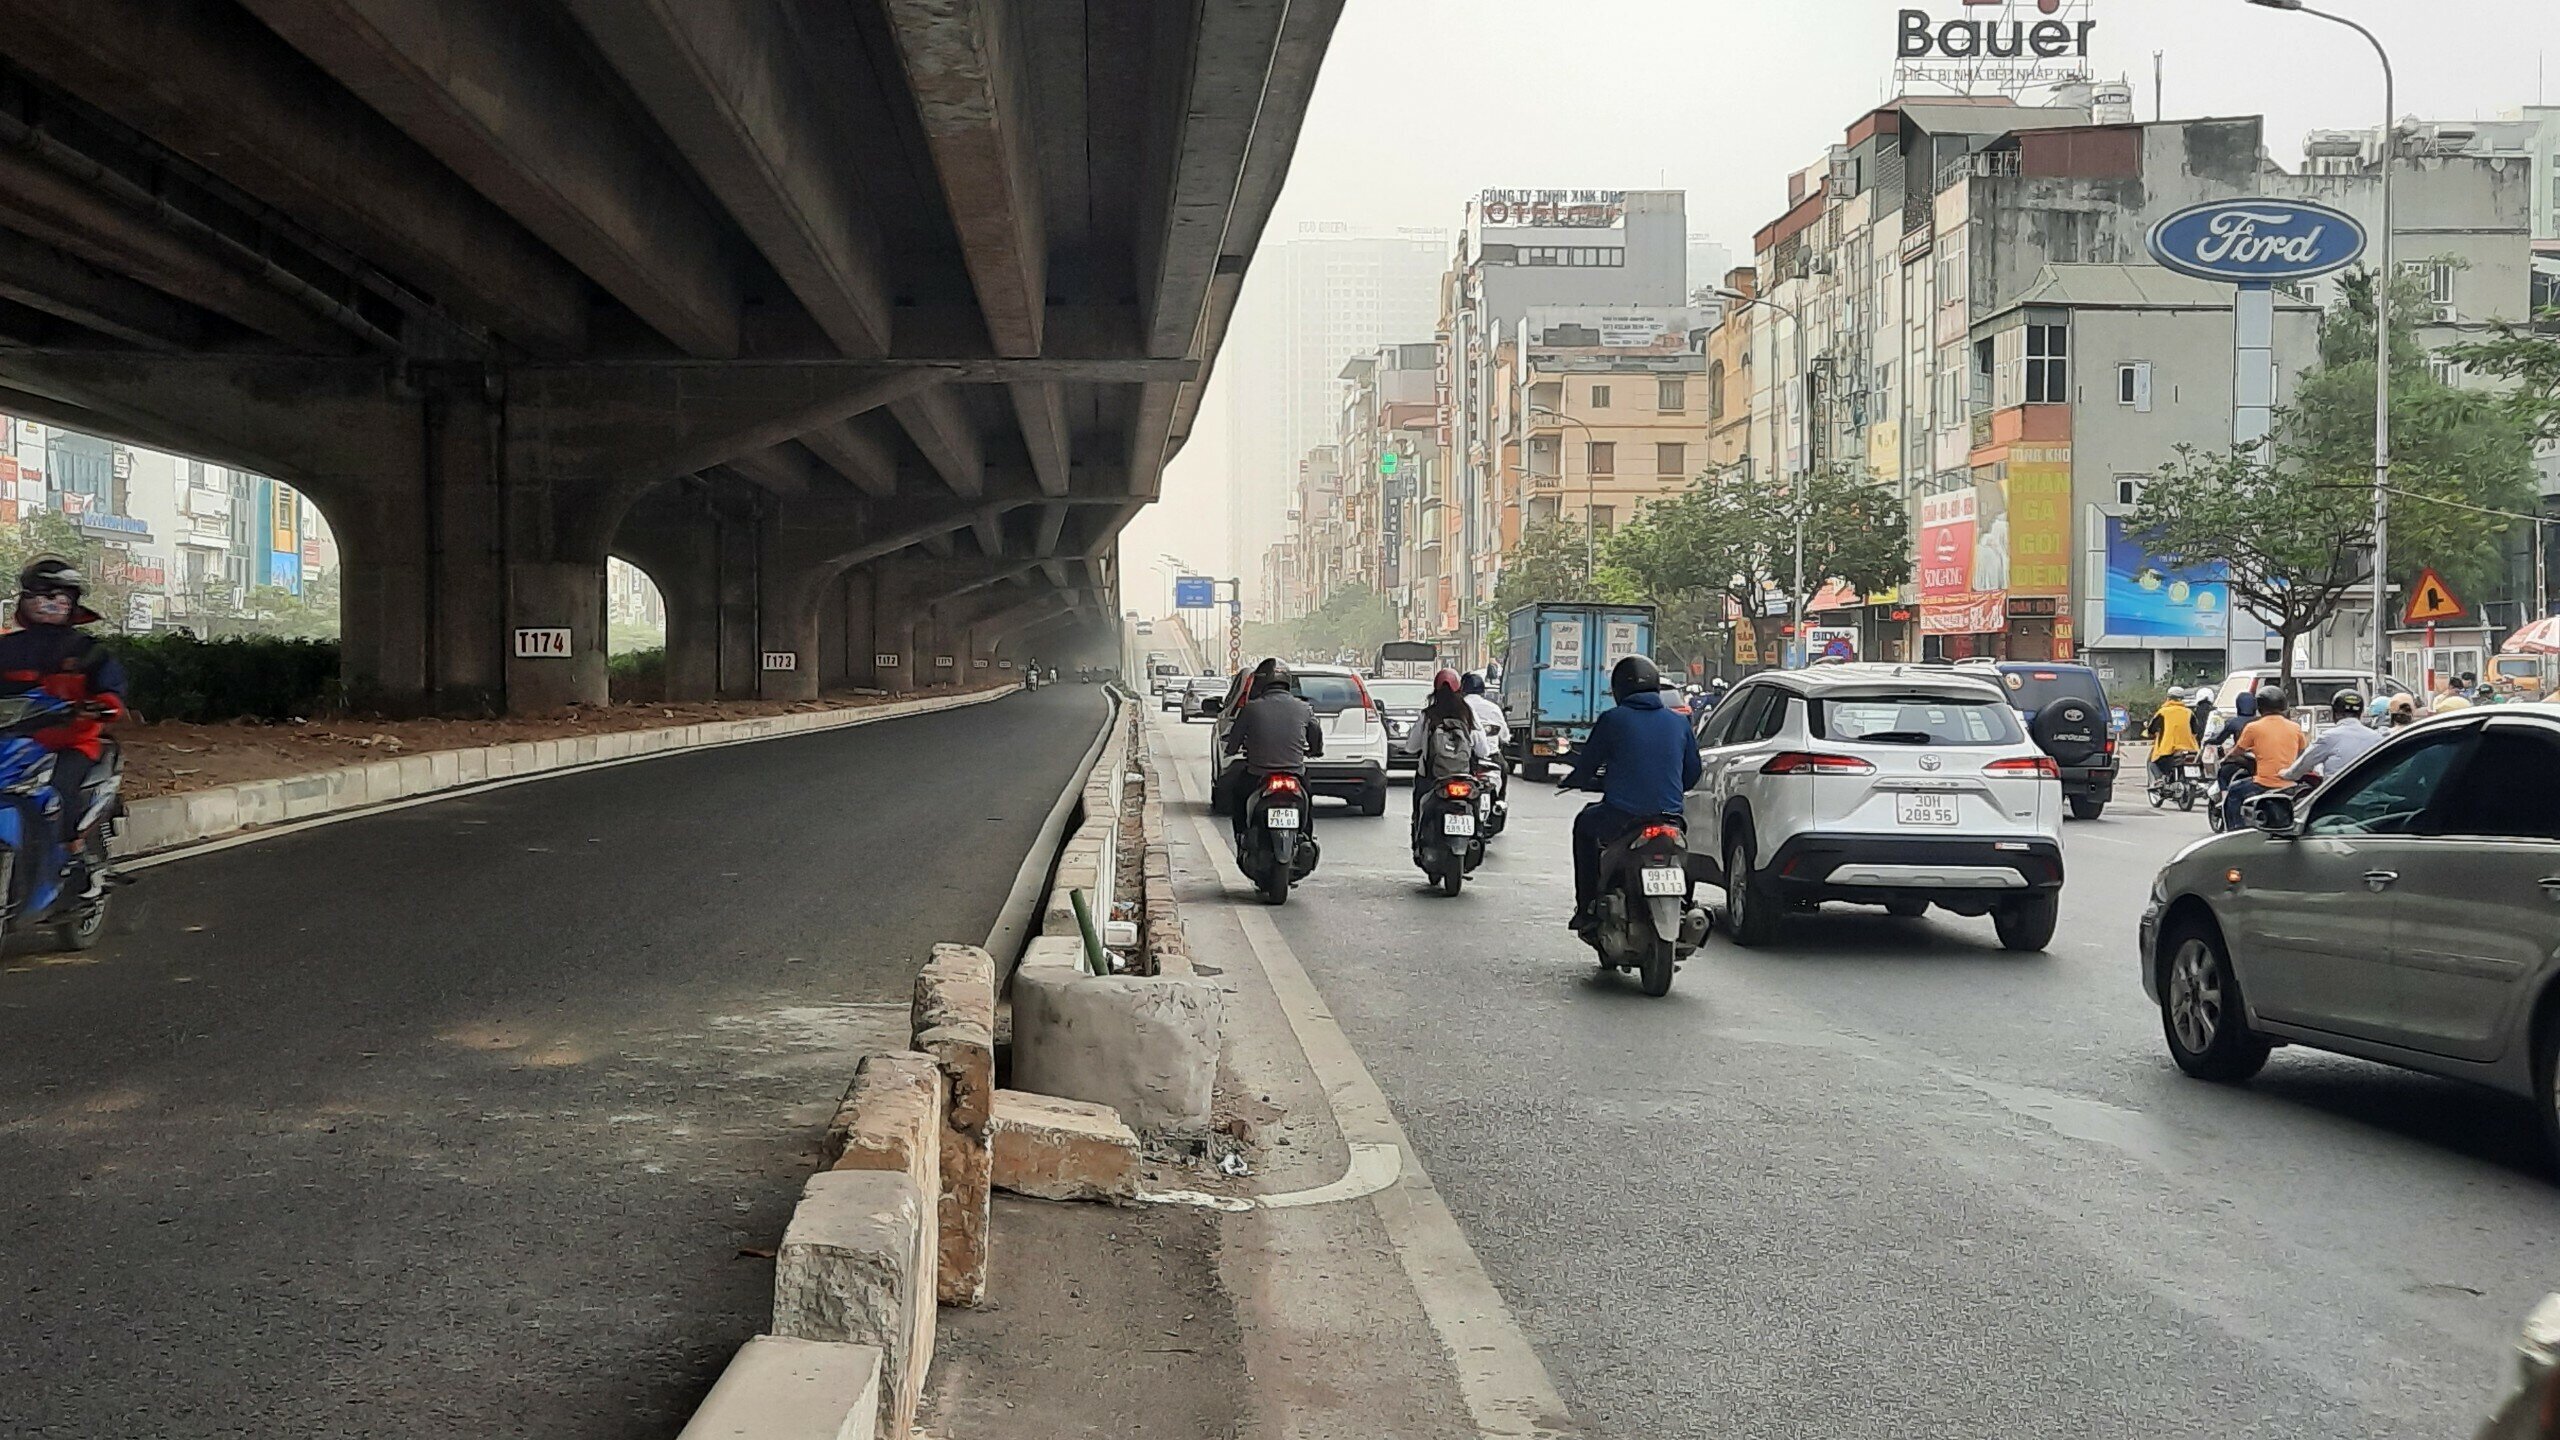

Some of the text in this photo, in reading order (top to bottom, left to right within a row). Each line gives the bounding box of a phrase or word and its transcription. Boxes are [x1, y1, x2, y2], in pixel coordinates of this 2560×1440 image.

[1898, 9, 2097, 58] Bauer
[1954, 65, 1982, 81] NHÀ
[1517, 189, 1532, 203] TY
[2196, 211, 2326, 262] Ford
[1435, 345, 1450, 446] HOTEL
[2045, 447, 2071, 463] KHO
[2022, 499, 2056, 521] GA
[518, 631, 564, 653] T174
[765, 653, 793, 668] T173
[1915, 795, 1941, 808] 30H
